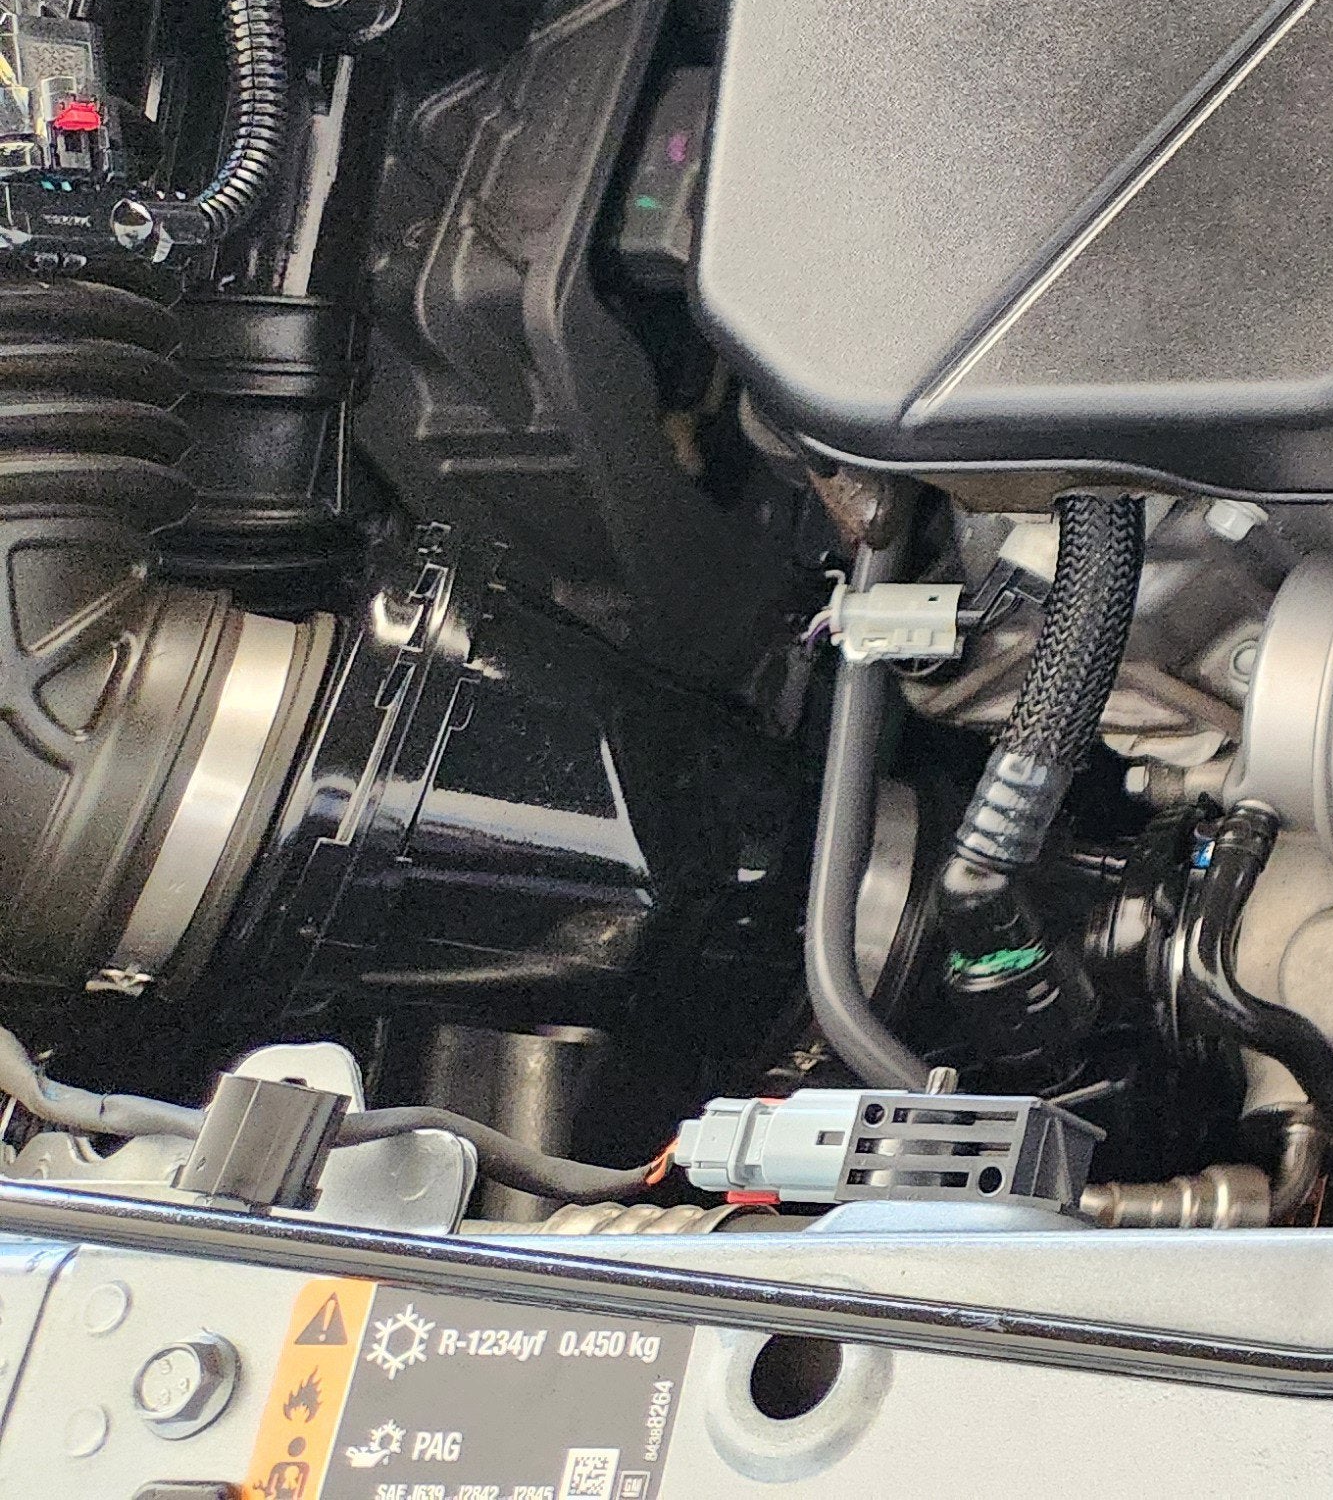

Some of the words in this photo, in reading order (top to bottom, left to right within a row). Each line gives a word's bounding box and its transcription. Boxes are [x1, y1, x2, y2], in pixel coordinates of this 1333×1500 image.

[437, 1328, 547, 1361] R-1234yf
[558, 1330, 625, 1359] 0.450
[628, 1332, 661, 1362] kg
[411, 1431, 464, 1463] PAG
[375, 1483, 408, 1500] SAE
